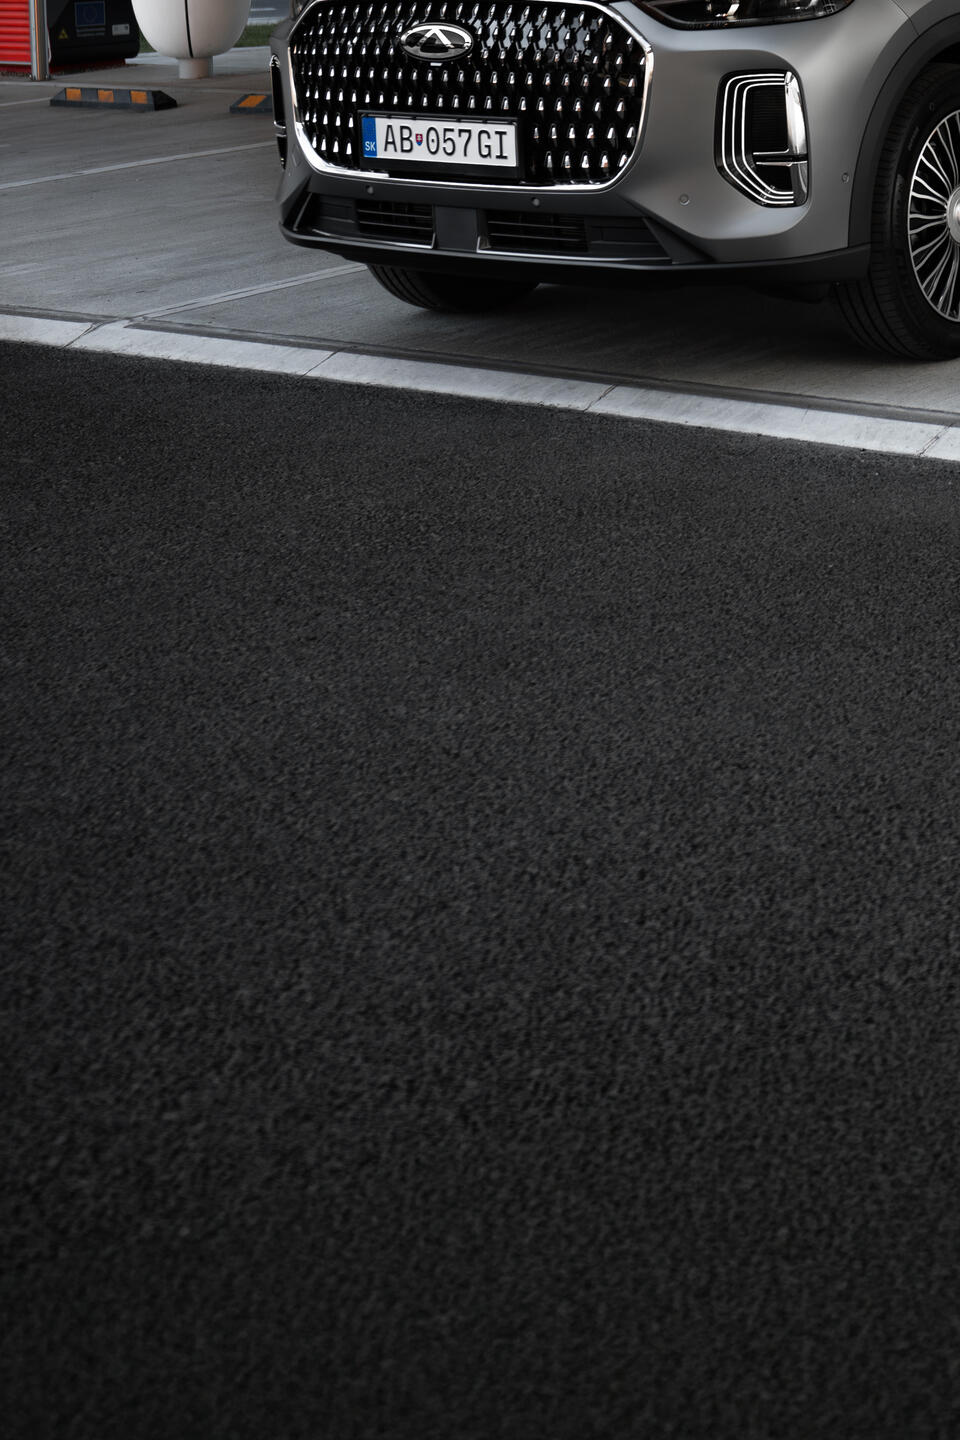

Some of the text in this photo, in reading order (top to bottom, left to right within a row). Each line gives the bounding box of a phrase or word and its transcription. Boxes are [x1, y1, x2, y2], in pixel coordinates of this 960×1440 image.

[365, 141, 376, 152] SK
[384, 124, 508, 159] AB 057GI
